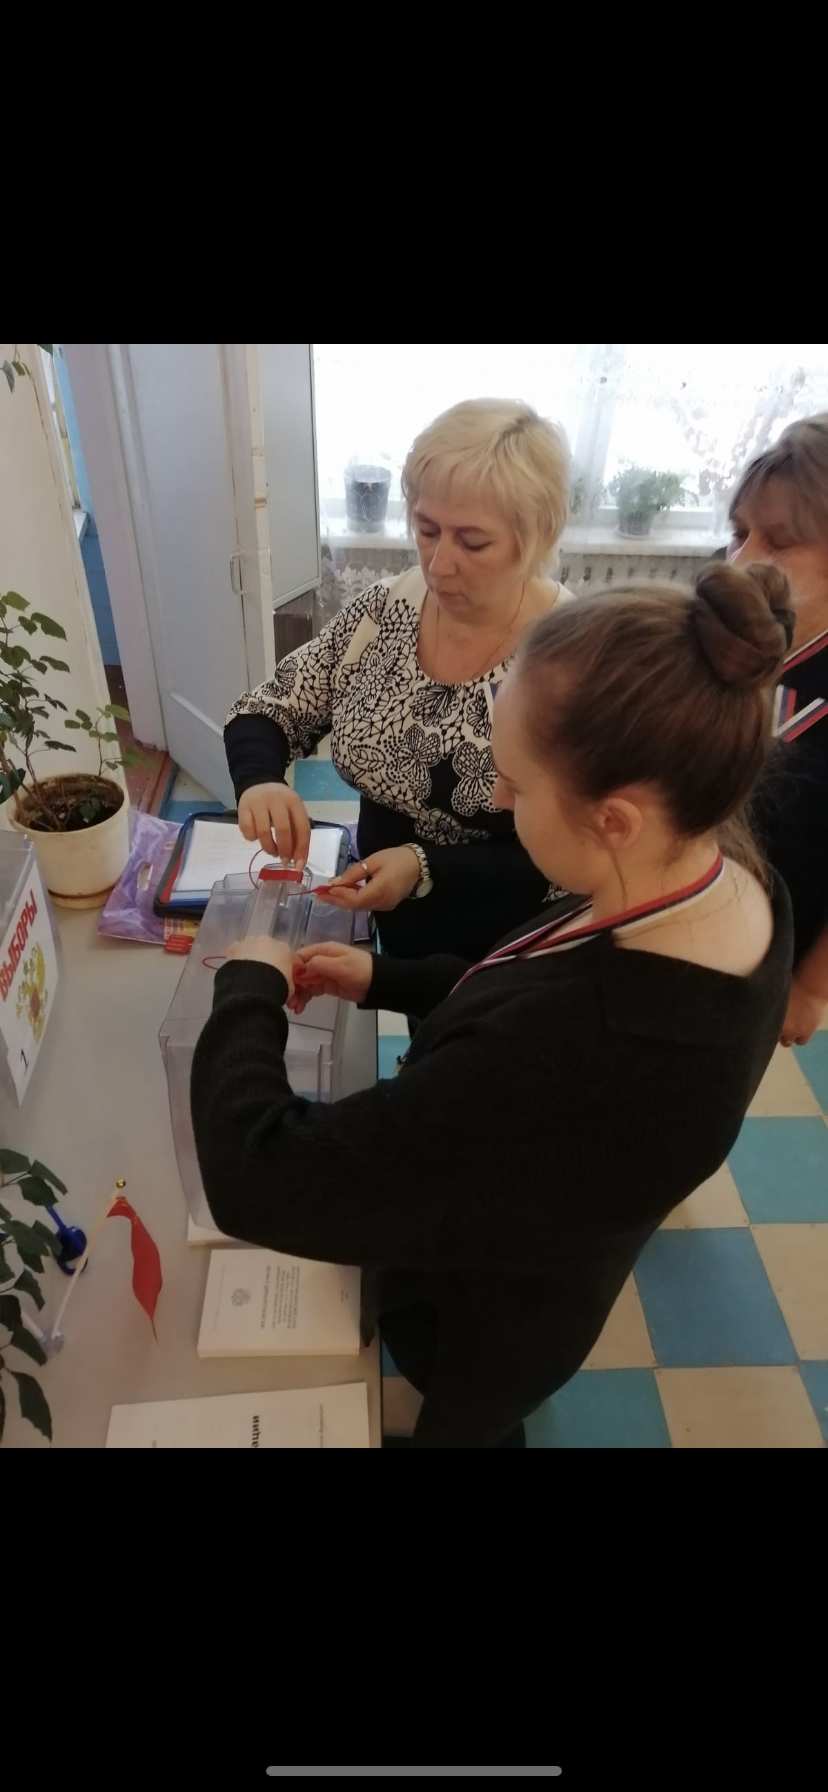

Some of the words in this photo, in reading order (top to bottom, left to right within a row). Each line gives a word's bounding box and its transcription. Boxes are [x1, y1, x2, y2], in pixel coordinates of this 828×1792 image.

[0, 889, 38, 1003] ВЫБОРЫ
[20, 1048, 30, 1076] 1
[251, 1415, 261, 1448] ации
